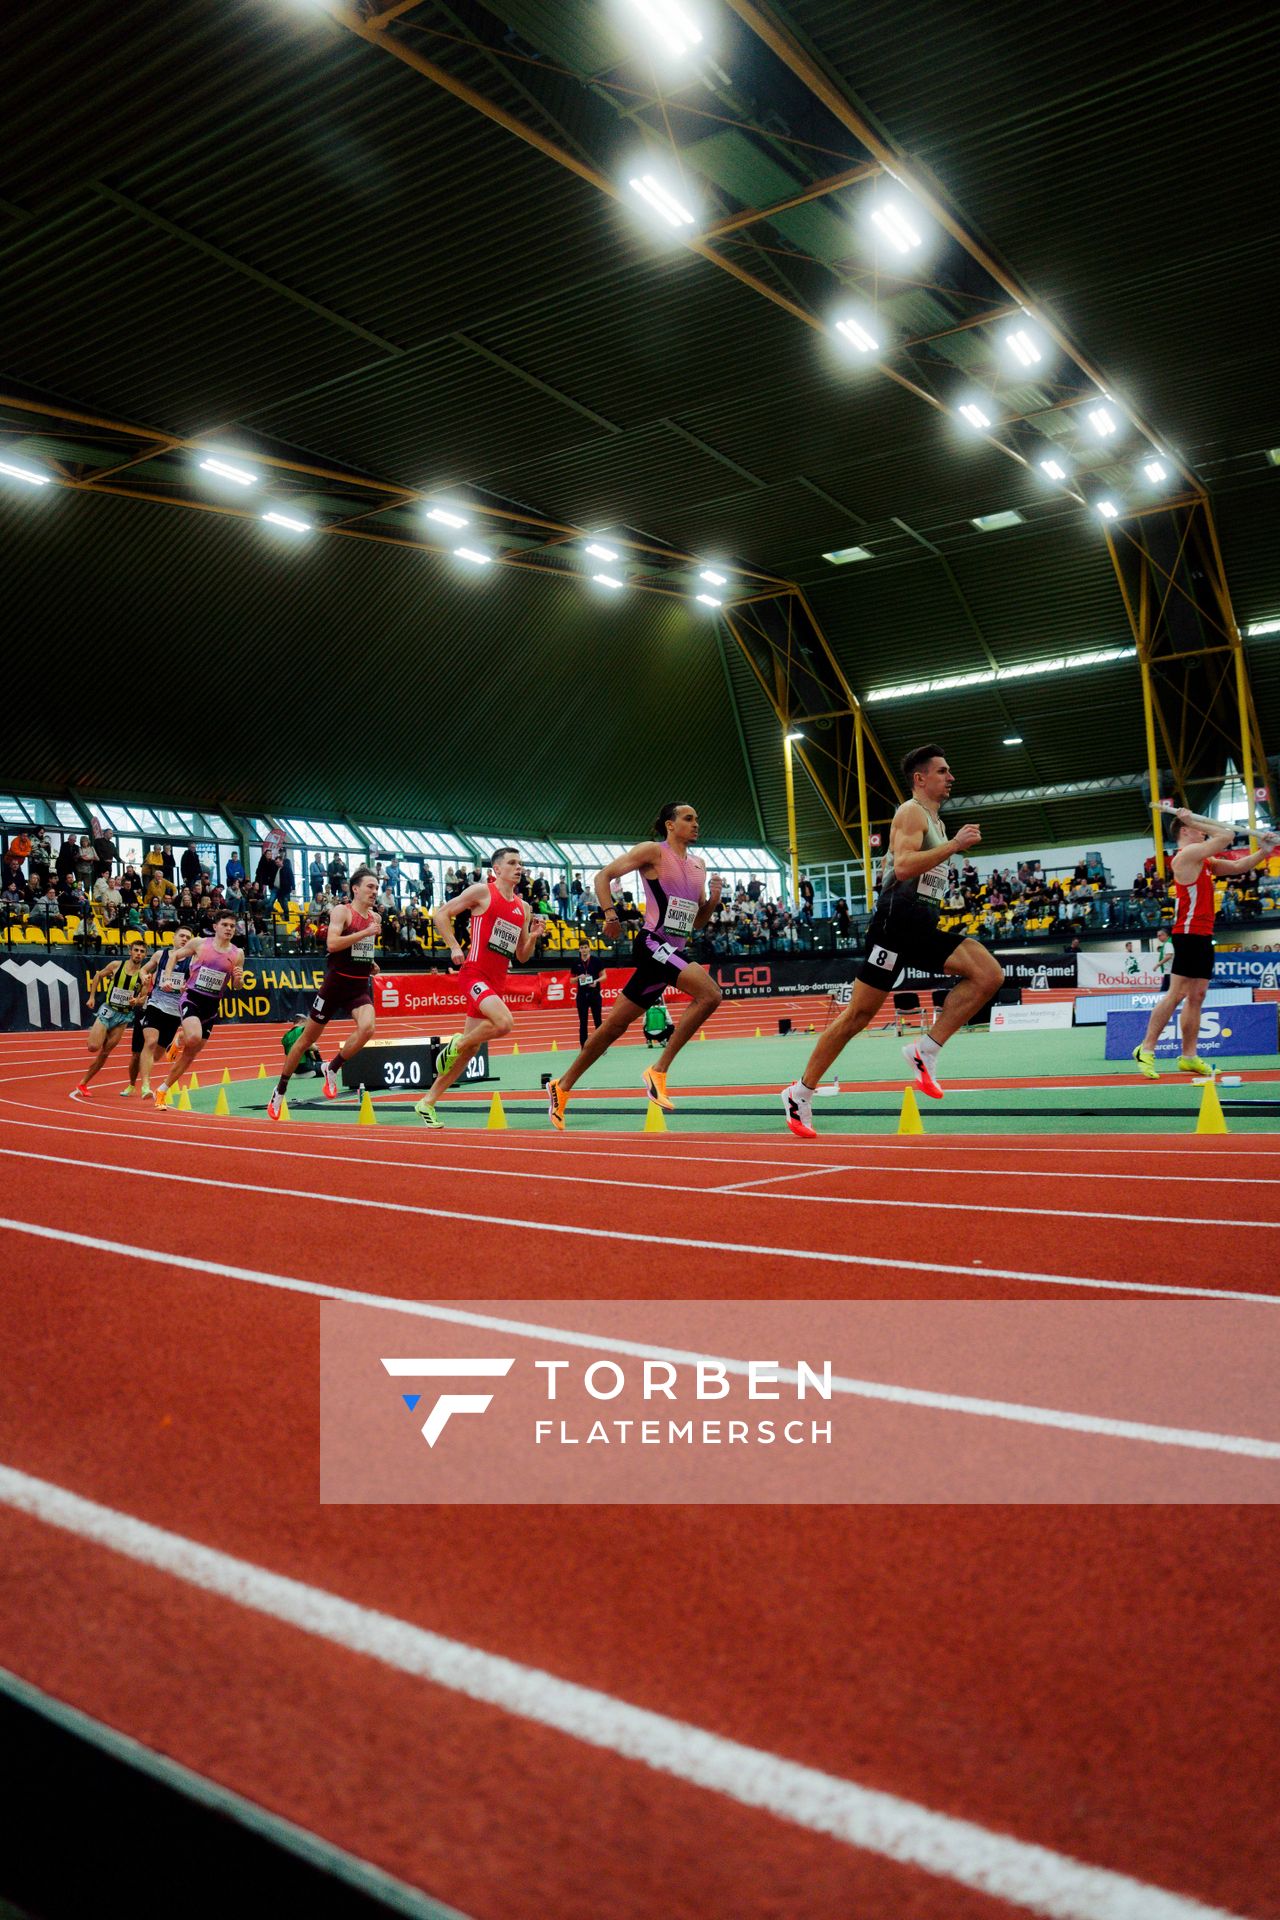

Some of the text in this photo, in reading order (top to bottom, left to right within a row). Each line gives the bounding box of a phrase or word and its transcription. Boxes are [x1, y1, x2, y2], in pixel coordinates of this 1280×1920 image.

[871, 836, 880, 845] Q
[876, 950, 888, 966] 8
[717, 966, 771, 987] LGO
[1016, 965, 1035, 976] the
[1038, 965, 1075, 977] Game!
[262, 970, 325, 990] HALLE
[1036, 976, 1045, 988] 4
[1264, 975, 1274, 987] 3
[472, 985, 482, 995] 6
[843, 989, 852, 1001] 5
[404, 992, 467, 1009] Sparkasse
[384, 1061, 420, 1084] 32.0
[466, 1056, 485, 1078] 32.0
